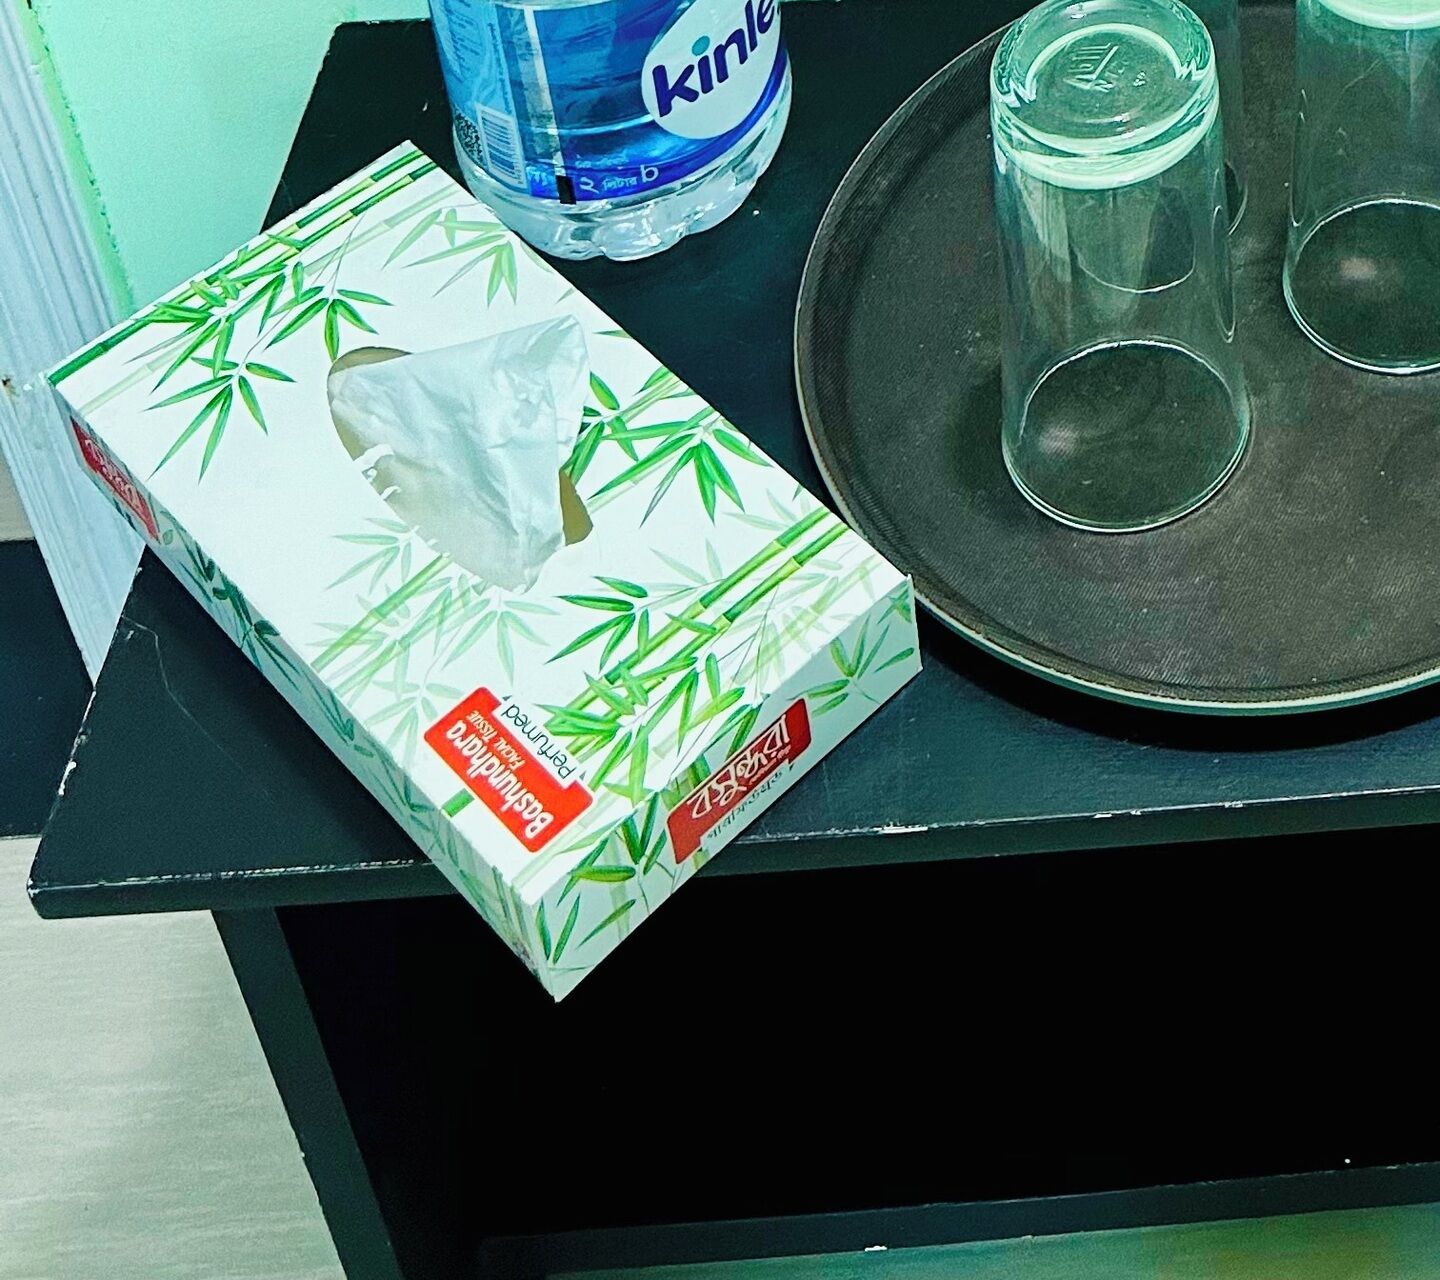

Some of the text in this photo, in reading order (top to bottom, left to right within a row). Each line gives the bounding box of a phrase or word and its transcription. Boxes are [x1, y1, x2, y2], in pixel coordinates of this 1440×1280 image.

[446, 719, 555, 840] Bashundhara
[500, 703, 577, 780] Perfumed
[686, 713, 790, 819] বসুন্ধরা
